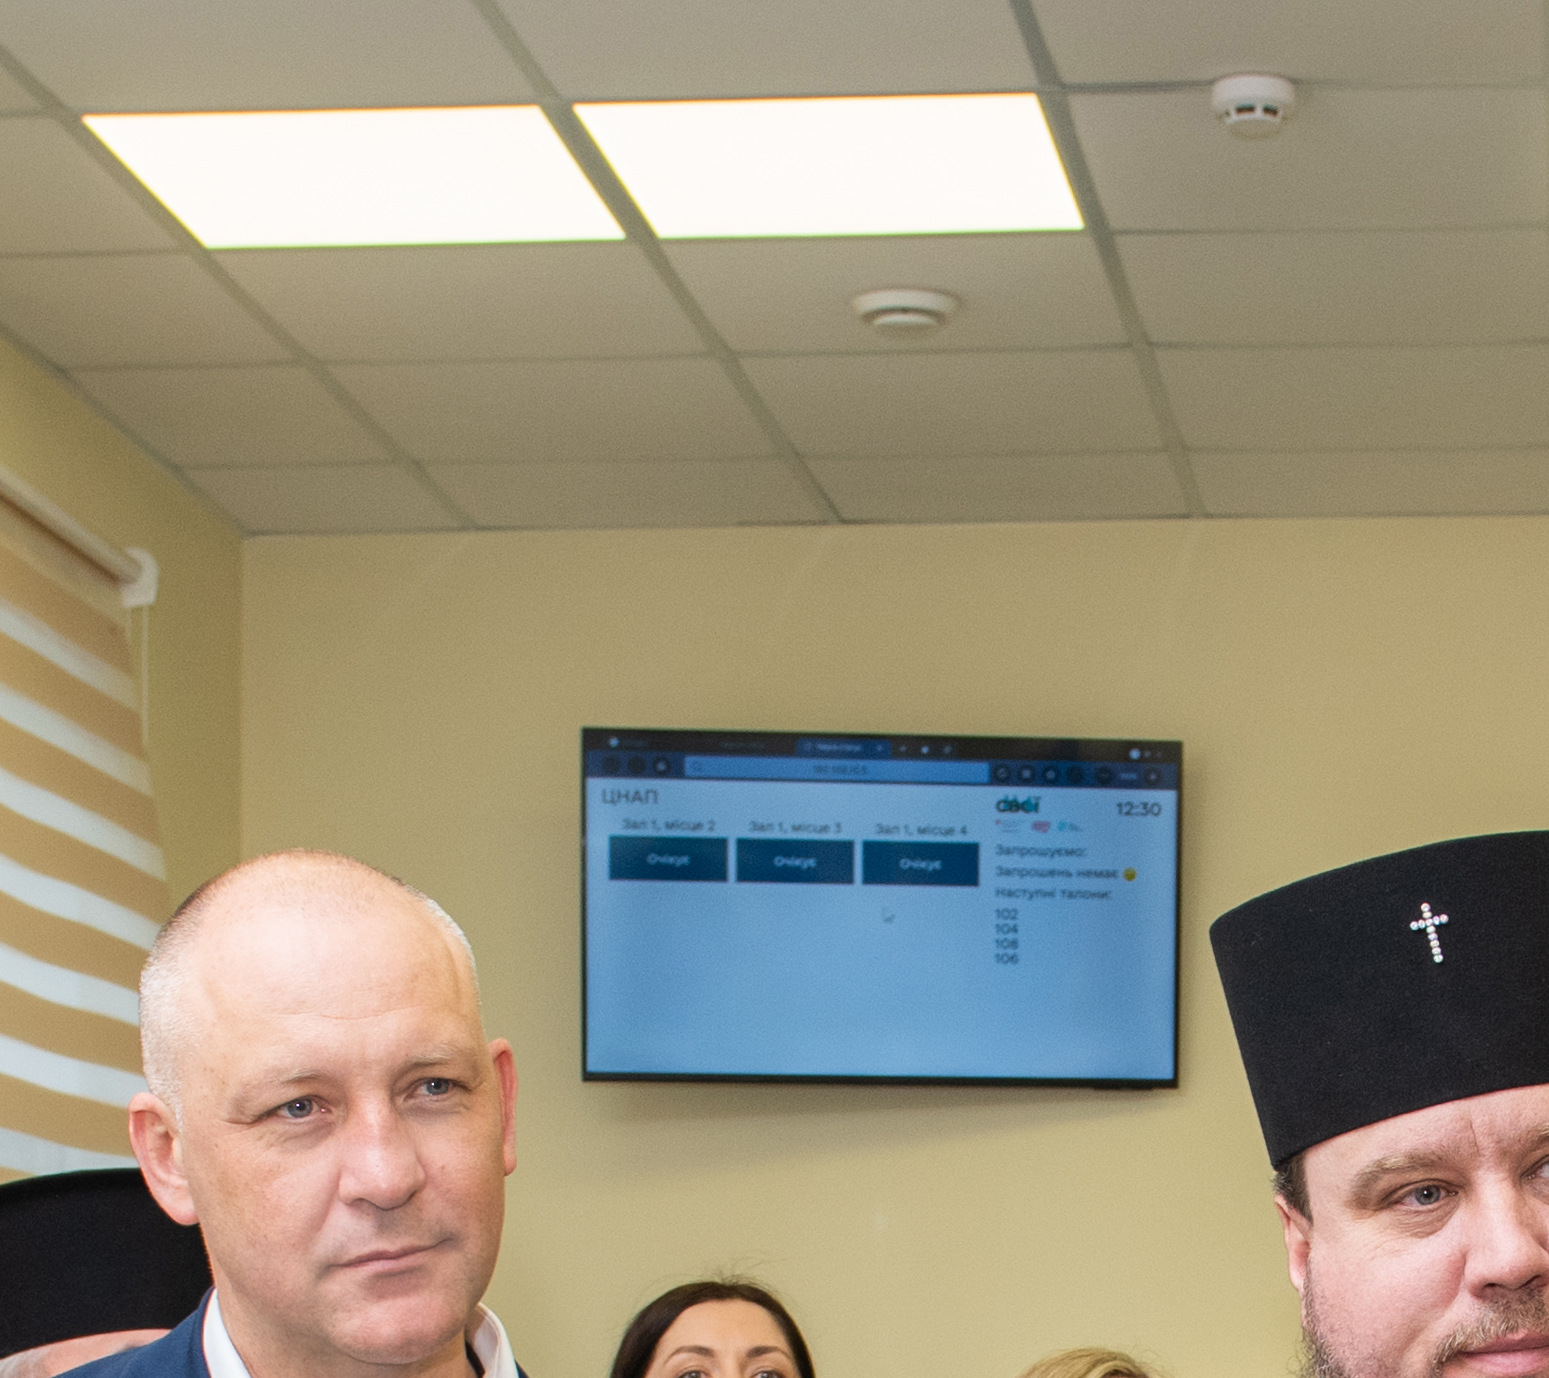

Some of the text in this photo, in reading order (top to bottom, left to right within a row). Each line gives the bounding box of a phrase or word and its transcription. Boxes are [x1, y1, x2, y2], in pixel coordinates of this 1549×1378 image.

[601, 788, 659, 806] ЦНАП
[1116, 801, 1162, 817] 12:30
[995, 922, 1019, 935] 104
